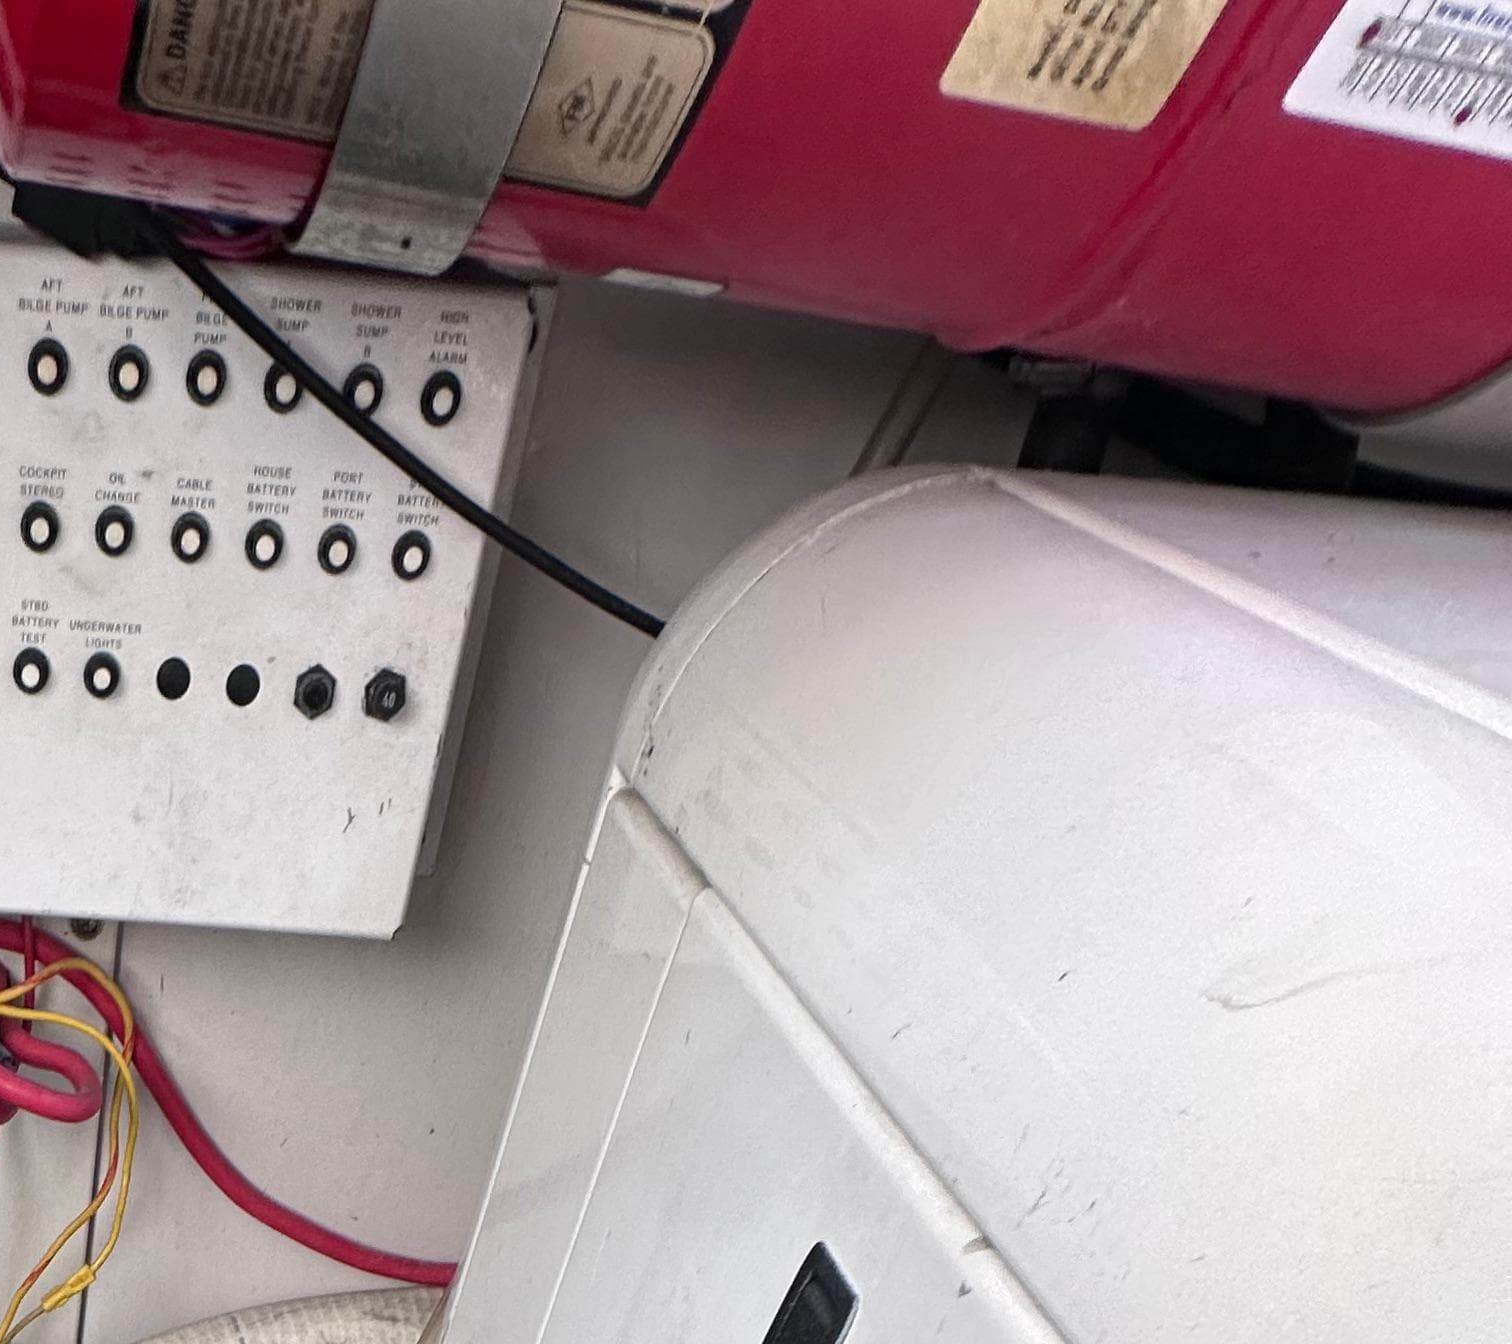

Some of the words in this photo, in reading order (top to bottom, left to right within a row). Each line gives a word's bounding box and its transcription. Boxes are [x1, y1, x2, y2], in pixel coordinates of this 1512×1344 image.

[18, 298, 52, 312] BILGE
[55, 299, 89, 315] PUMP
[270, 296, 323, 313] SHOWER
[350, 303, 402, 320] SHOWER
[99, 305, 132, 319] BILGE
[136, 306, 170, 322] PUMP
[440, 311, 470, 324] HIGH
[276, 318, 310, 333] SUMP
[356, 324, 389, 338] SUMP
[194, 332, 227, 346] PUMP
[433, 331, 468, 346] LEVEL
[428, 351, 468, 366] ALARM
[19, 465, 67, 481] COCKPIT
[253, 465, 293, 480] HOUSE
[333, 471, 364, 485] PORT
[19, 484, 65, 499] STEREO
[176, 477, 213, 492] CABLE
[246, 483, 297, 498] BATTERY
[94, 490, 142, 505] CHANGE
[170, 495, 216, 510] MASTER
[321, 489, 373, 503] BATTERY
[397, 494, 442, 509] BATTER
[247, 501, 290, 515] SWITCH
[322, 507, 366, 521] SWITCH
[397, 512, 440, 527] SWITCH
[21, 600, 49, 613] STBD
[12, 616, 60, 630] BATTERY
[69, 620, 142, 636] UNDERWATER
[20, 632, 47, 645] TEST
[85, 637, 122, 650] LIGHTS
